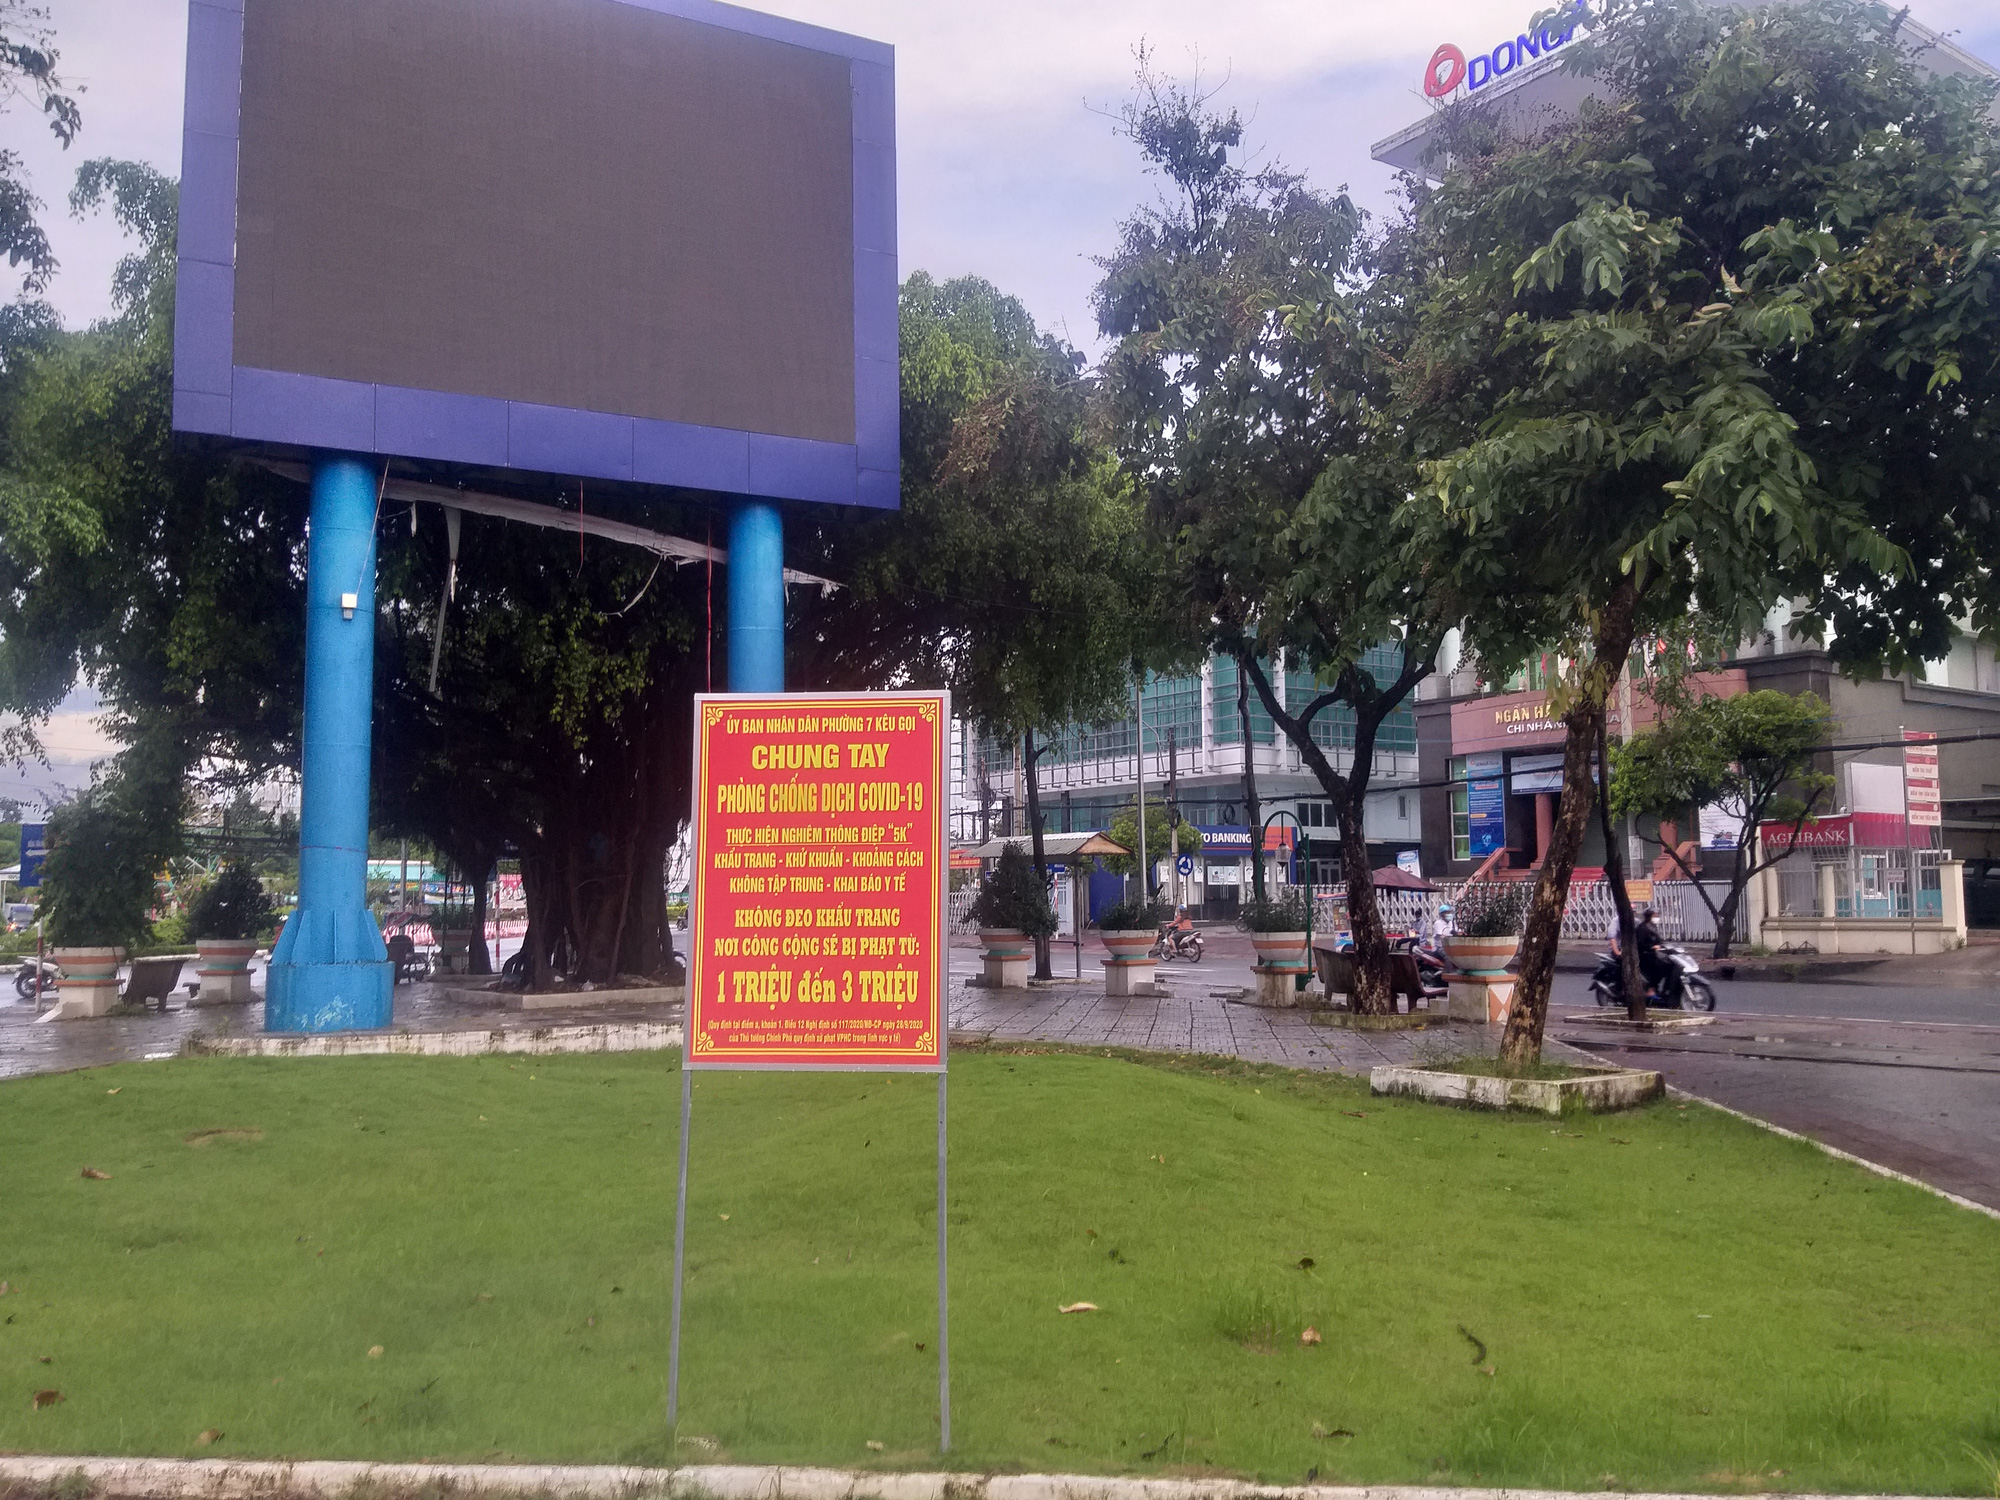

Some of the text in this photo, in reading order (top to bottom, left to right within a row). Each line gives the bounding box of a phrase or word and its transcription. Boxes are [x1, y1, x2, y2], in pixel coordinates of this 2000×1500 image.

[727, 714, 916, 734] ỦY BAN NHÂN DÂN PHƯỜNG 7 KÊU GỌI
[1495, 706, 1530, 724] NGÂN
[1507, 724, 1525, 734] CHI
[752, 744, 890, 770] CHUNG TAY
[718, 773, 923, 818] PHÒNG CHỐNG DỊCH COVID-19
[726, 827, 752, 847] THỰC
[755, 825, 779, 847] HIỆN
[781, 825, 823, 844] NGHIÊM
[825, 824, 858, 843] THÔNG
[861, 824, 885, 846] ĐIỆP
[1212, 833, 1252, 844] BANKING
[715, 848, 741, 869] KHẨU
[744, 853, 776, 868] TRANG
[786, 847, 808, 868] KHỬ
[809, 847, 843, 868] KHUẨN
[853, 846, 894, 867] KHOẢNG
[897, 848, 924, 867] CÁCH
[730, 874, 765, 893] KHÔNG
[768, 874, 788, 896] TẬP
[790, 877, 824, 892] TRUNG
[834, 877, 858, 892] KHAI
[861, 873, 882, 892] BÁO
[885, 877, 891, 891] Y
[894, 872, 906, 891] TẾ
[735, 902, 901, 928] KHÔNG ĐEO KHẨU TRANG
[715, 934, 920, 960] NƠI CÔNG CỘNG SẼ BỊ PHẠT TỪ:
[718, 963, 919, 1011] 1 TRIỆU đến 3 TRIỆU
[798, 1020, 805, 1029] 12
